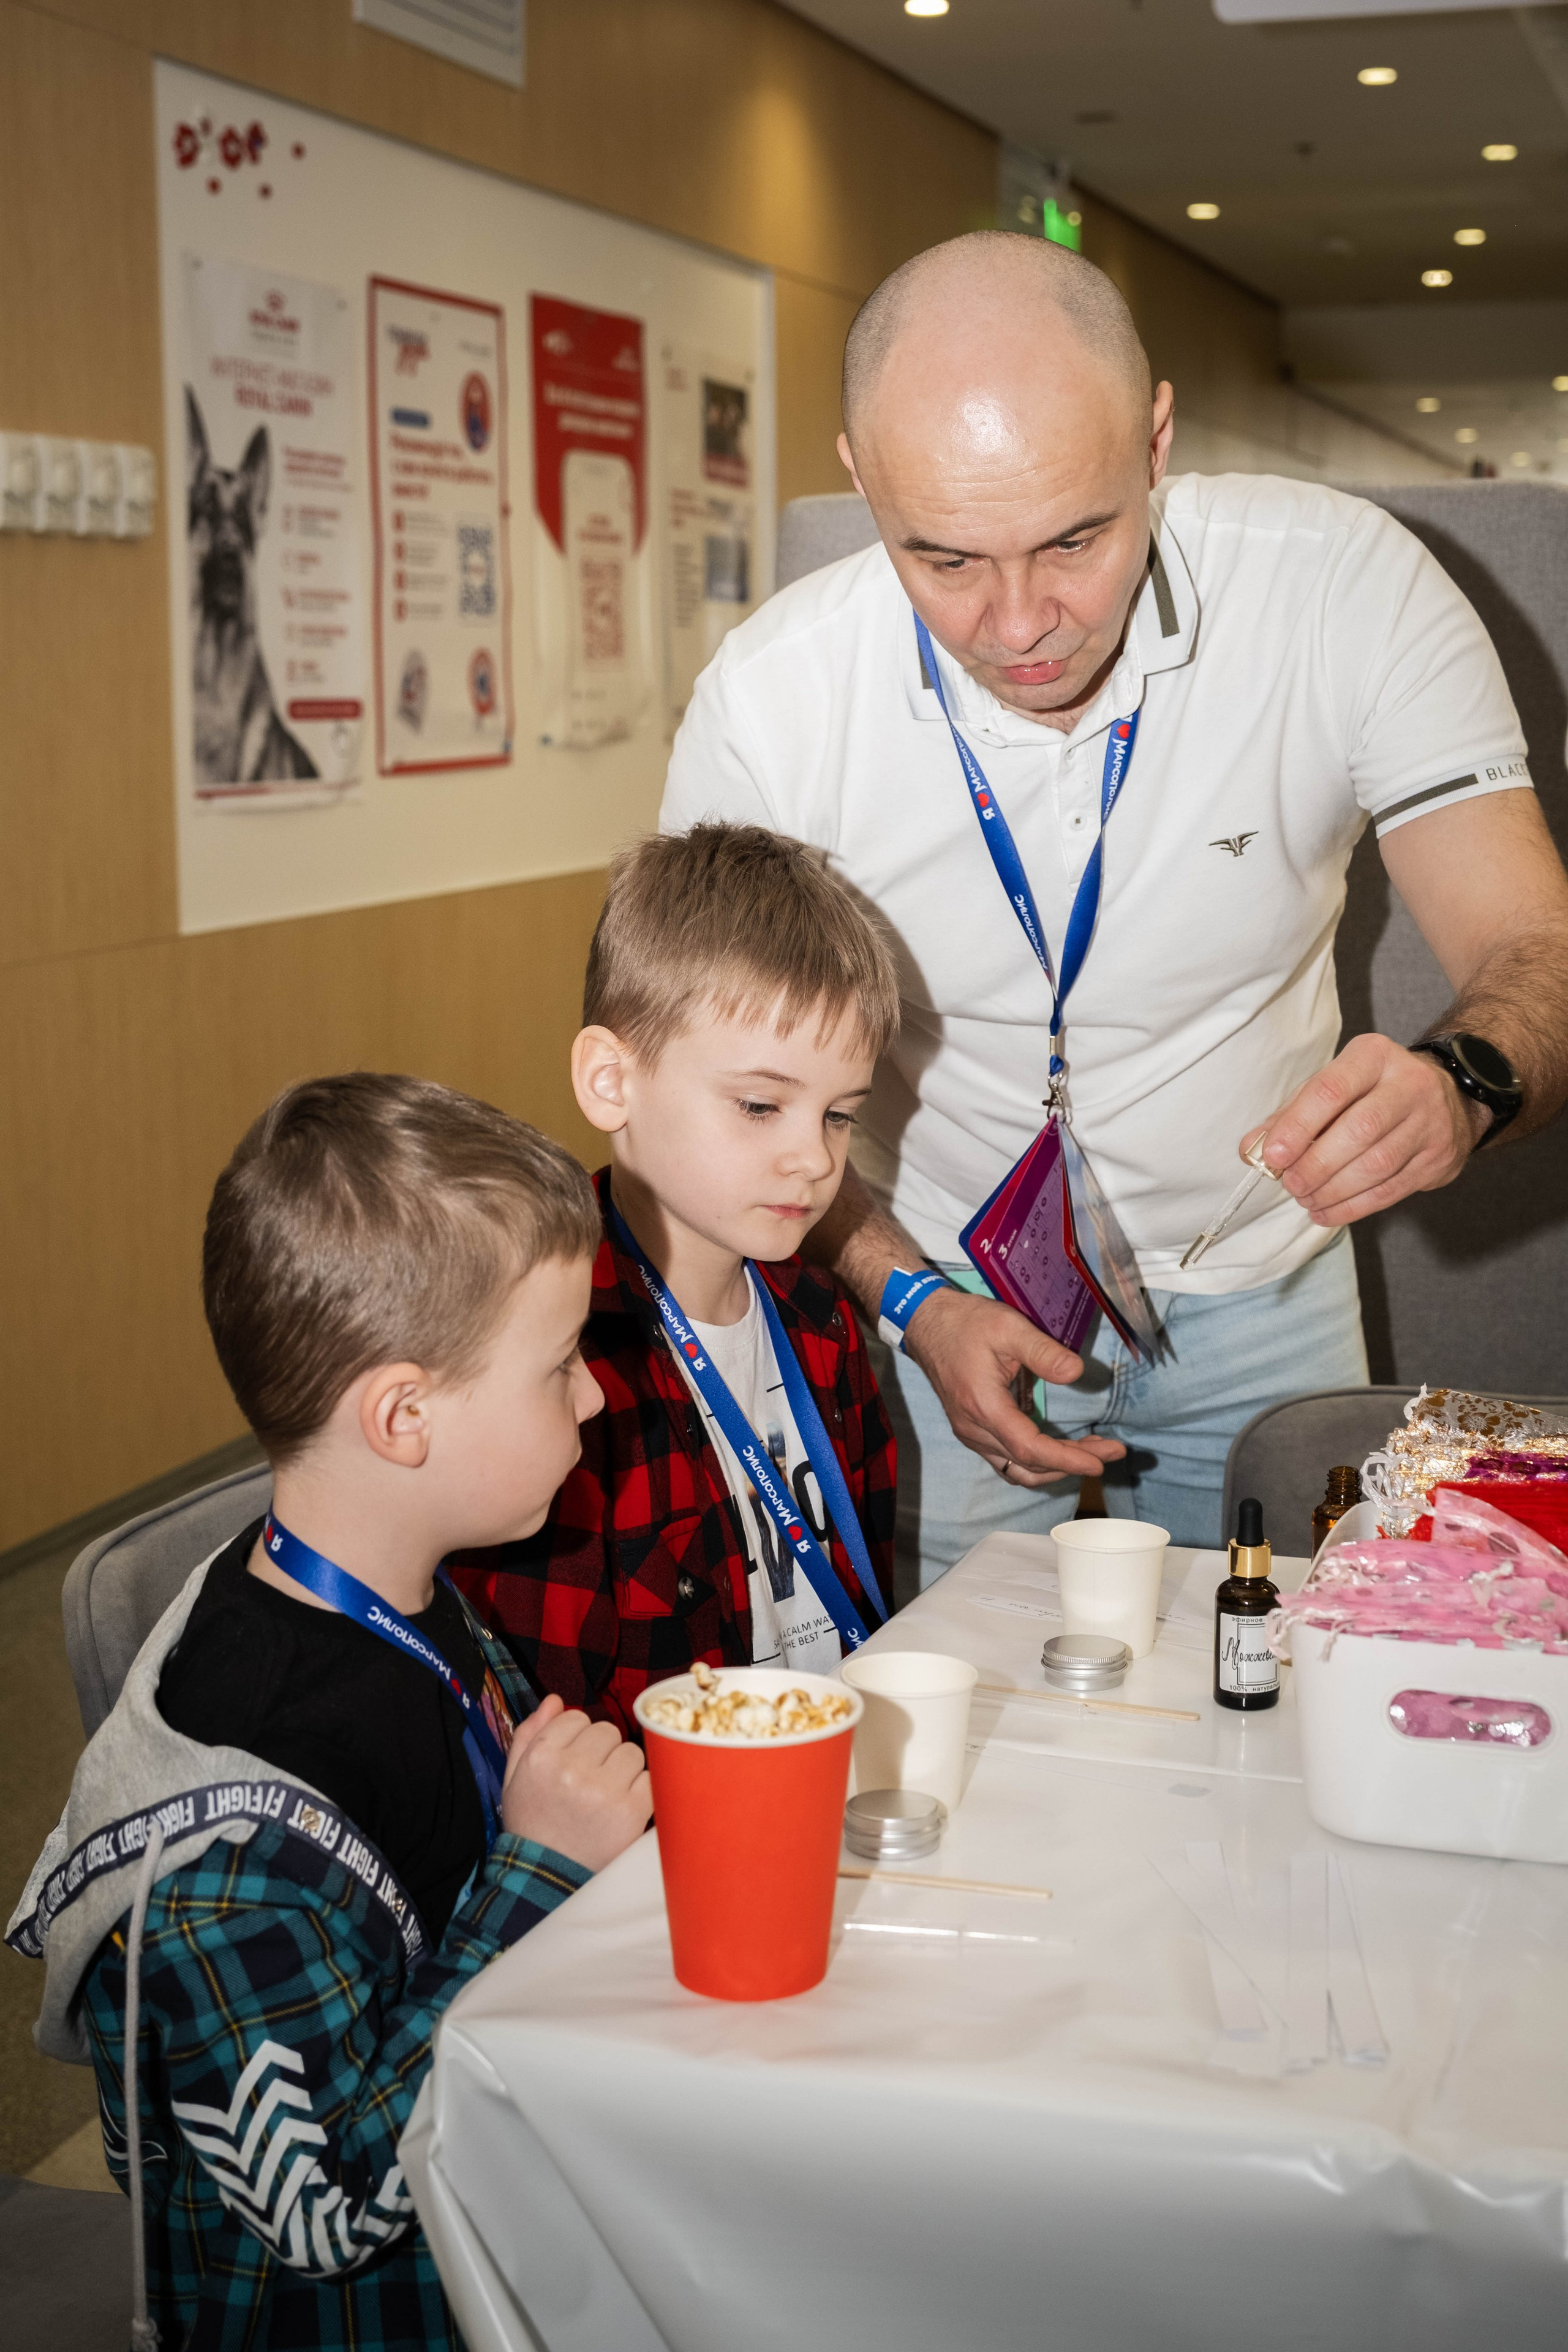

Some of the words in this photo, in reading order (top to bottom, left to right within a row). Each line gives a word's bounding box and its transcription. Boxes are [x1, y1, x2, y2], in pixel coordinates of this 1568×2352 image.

[982, 807, 995, 820] Я
[693, 1357, 707, 1371] Я
[271, 1534, 283, 1551] Я
[796, 1539, 812, 1553] Я
[786, 1621, 812, 1637] CALM
[797, 1631, 818, 1646] BEST
[336, 1833, 380, 1887] FIGHT
